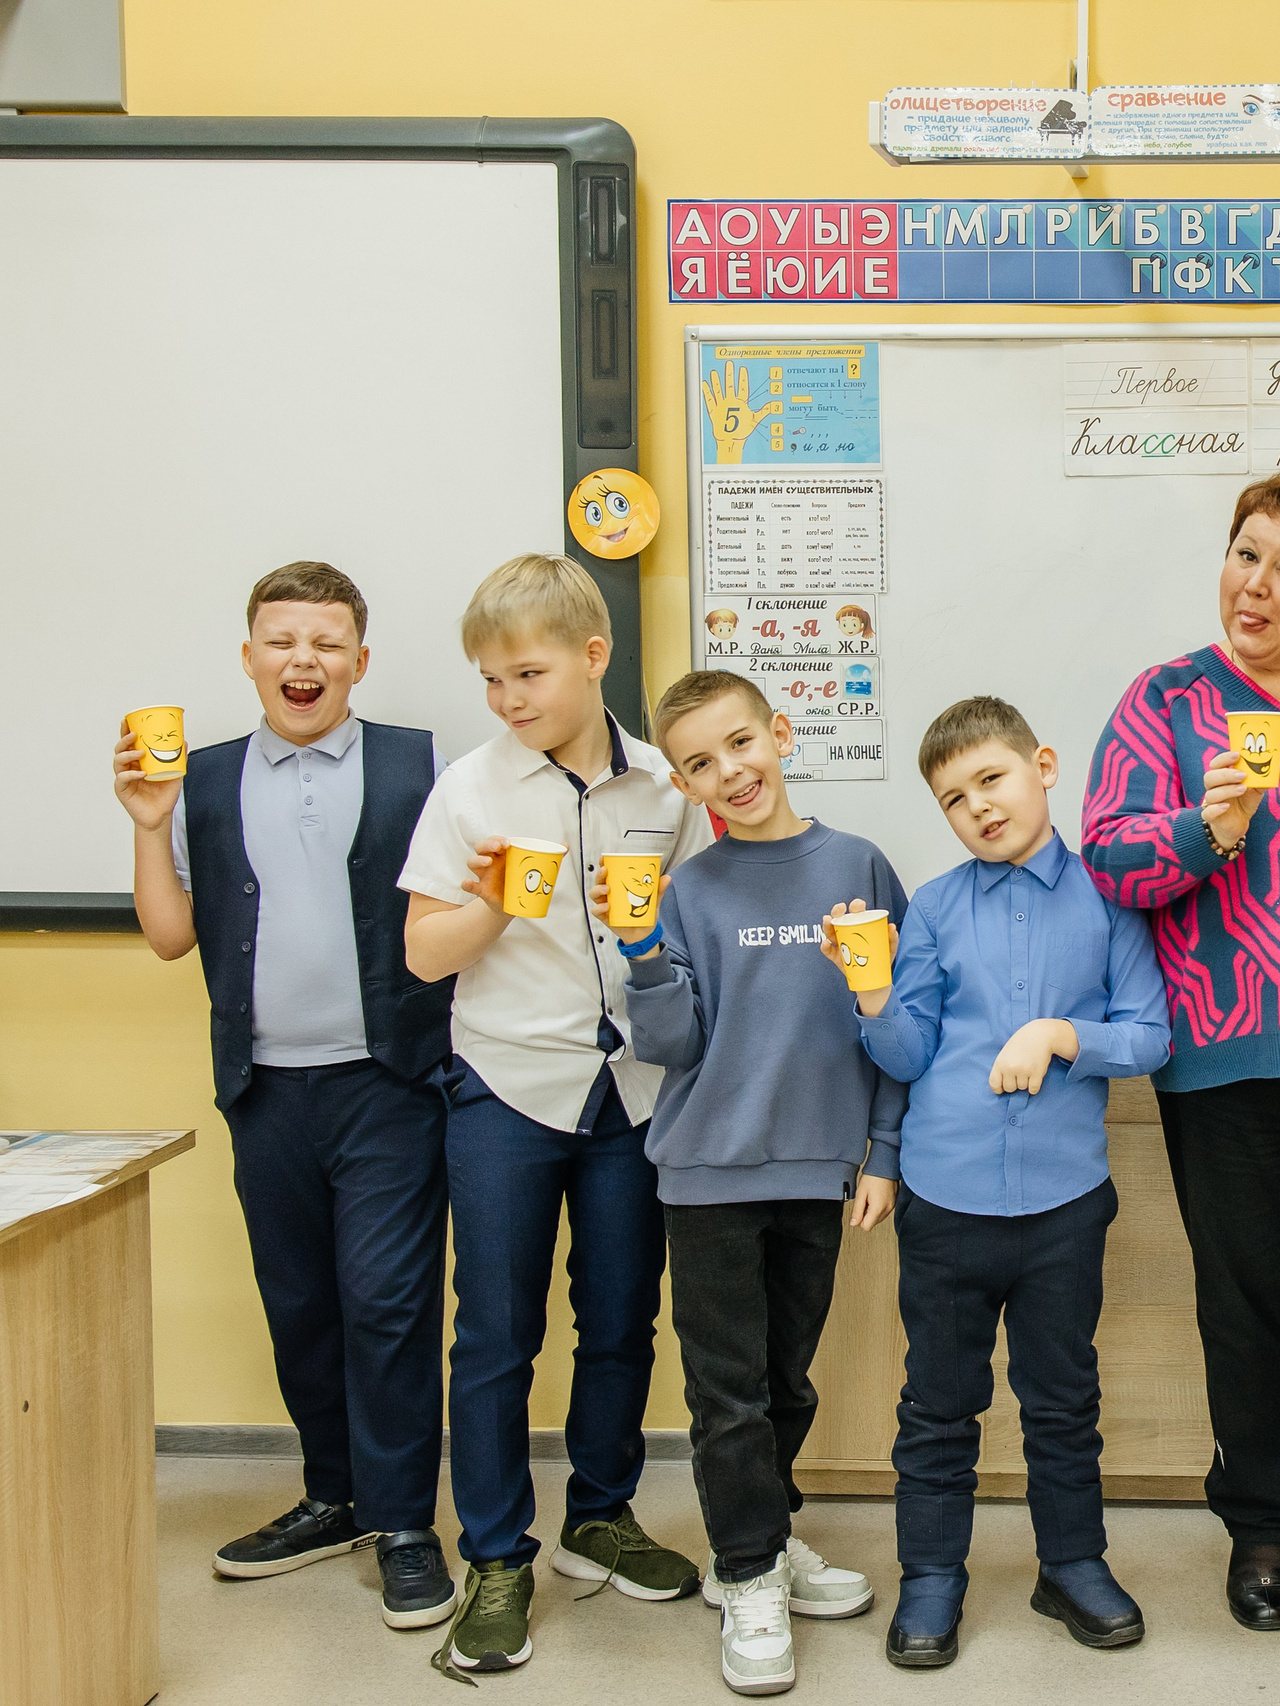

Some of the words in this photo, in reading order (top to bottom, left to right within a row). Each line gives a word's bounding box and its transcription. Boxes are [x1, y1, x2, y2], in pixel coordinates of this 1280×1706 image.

[890, 97, 1047, 116] олицетворение
[1107, 92, 1227, 112] сравнение
[918, 116, 972, 125] придание
[718, 348, 772, 357] Однородные
[806, 348, 863, 357] предложения
[787, 367, 828, 375] отвечают
[787, 381, 829, 389] относятся
[843, 381, 868, 389] слову
[1110, 365, 1201, 405] Первое
[788, 405, 813, 414] могут
[817, 403, 837, 412] быть
[723, 407, 741, 433] 5
[1070, 417, 1245, 456] Классная
[718, 487, 756, 495] ПАДЕЖИ
[786, 486, 874, 496] СУЩЕСТВИТЕЛЬНЫХ
[731, 501, 754, 510] ПАДЕЖИ
[755, 598, 828, 610] склонение
[708, 641, 743, 654] М.Р.
[750, 641, 781, 655] Ваня
[793, 641, 829, 655] Мила
[837, 640, 875, 653] Ж.Р.
[749, 658, 758, 671] 2
[761, 661, 834, 672] склонение
[805, 705, 831, 715] окно
[837, 702, 879, 716] СР.Р.
[830, 746, 845, 760] НА
[847, 744, 882, 761] КОНЦЕ
[738, 926, 775, 947] KEEP
[778, 924, 828, 945] SMILIN
